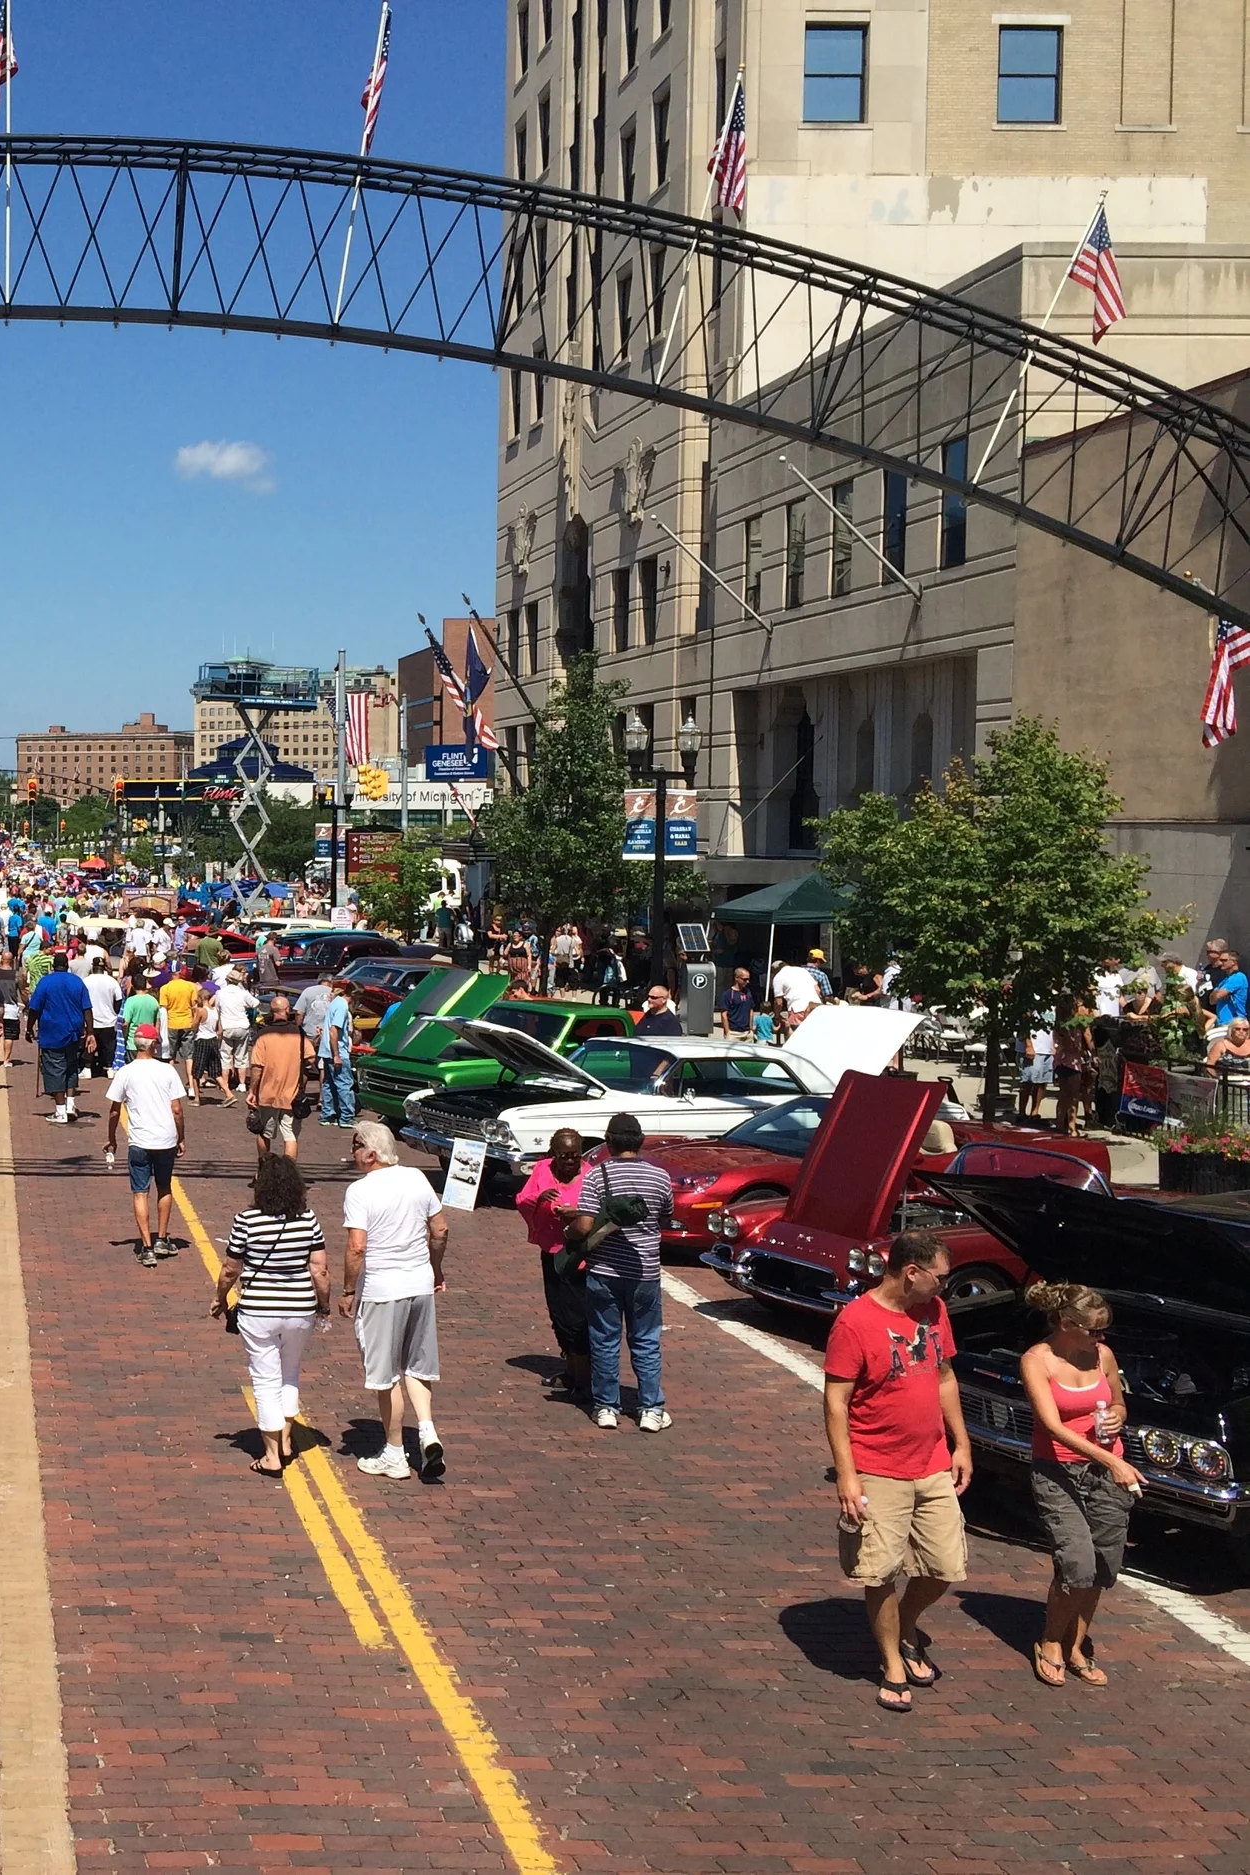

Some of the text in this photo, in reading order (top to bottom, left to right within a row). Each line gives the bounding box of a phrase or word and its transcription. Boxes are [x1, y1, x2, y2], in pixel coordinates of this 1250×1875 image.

[441, 752, 464, 760] FLINT
[431, 760, 464, 768] GENESEE
[202, 785, 246, 802] Flint
[351, 790, 402, 804] nivsity
[407, 790, 417, 802] of
[420, 790, 472, 805] Michigan
